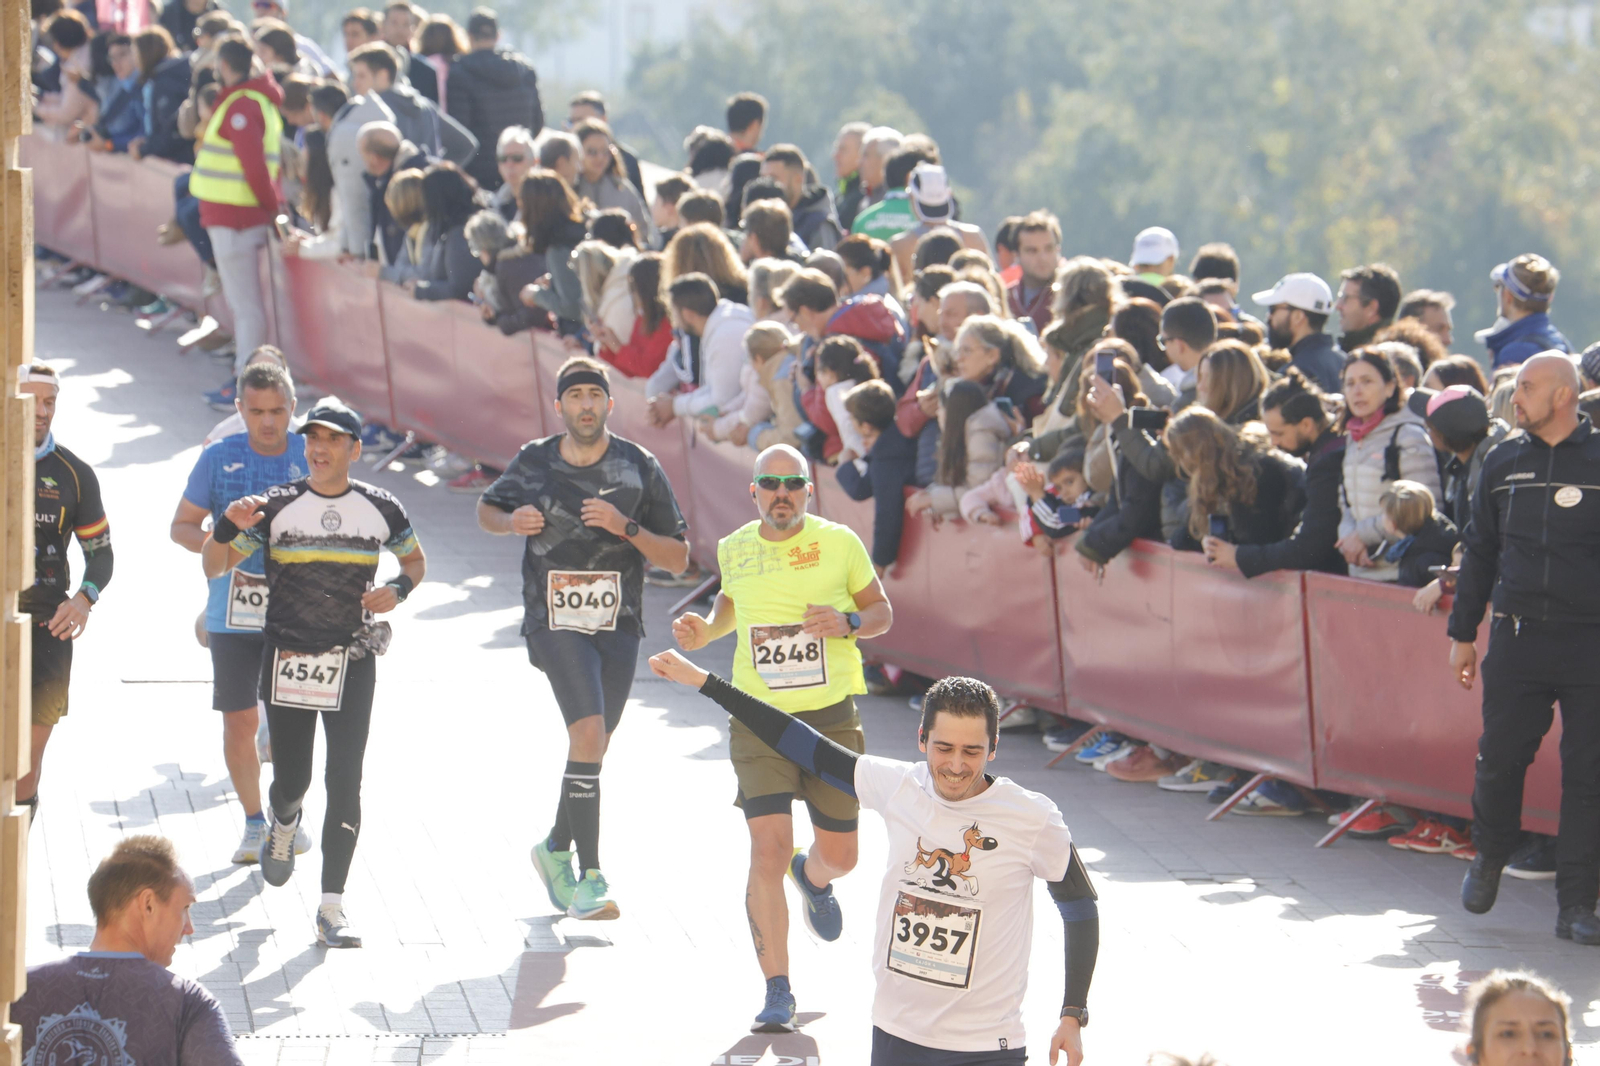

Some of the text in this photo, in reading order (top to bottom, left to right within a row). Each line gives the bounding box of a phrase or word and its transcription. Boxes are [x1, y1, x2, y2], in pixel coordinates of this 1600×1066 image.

[554, 590, 616, 609] 3040
[757, 642, 819, 664] 2648
[279, 661, 340, 685] 4547
[896, 917, 969, 955] 3957
